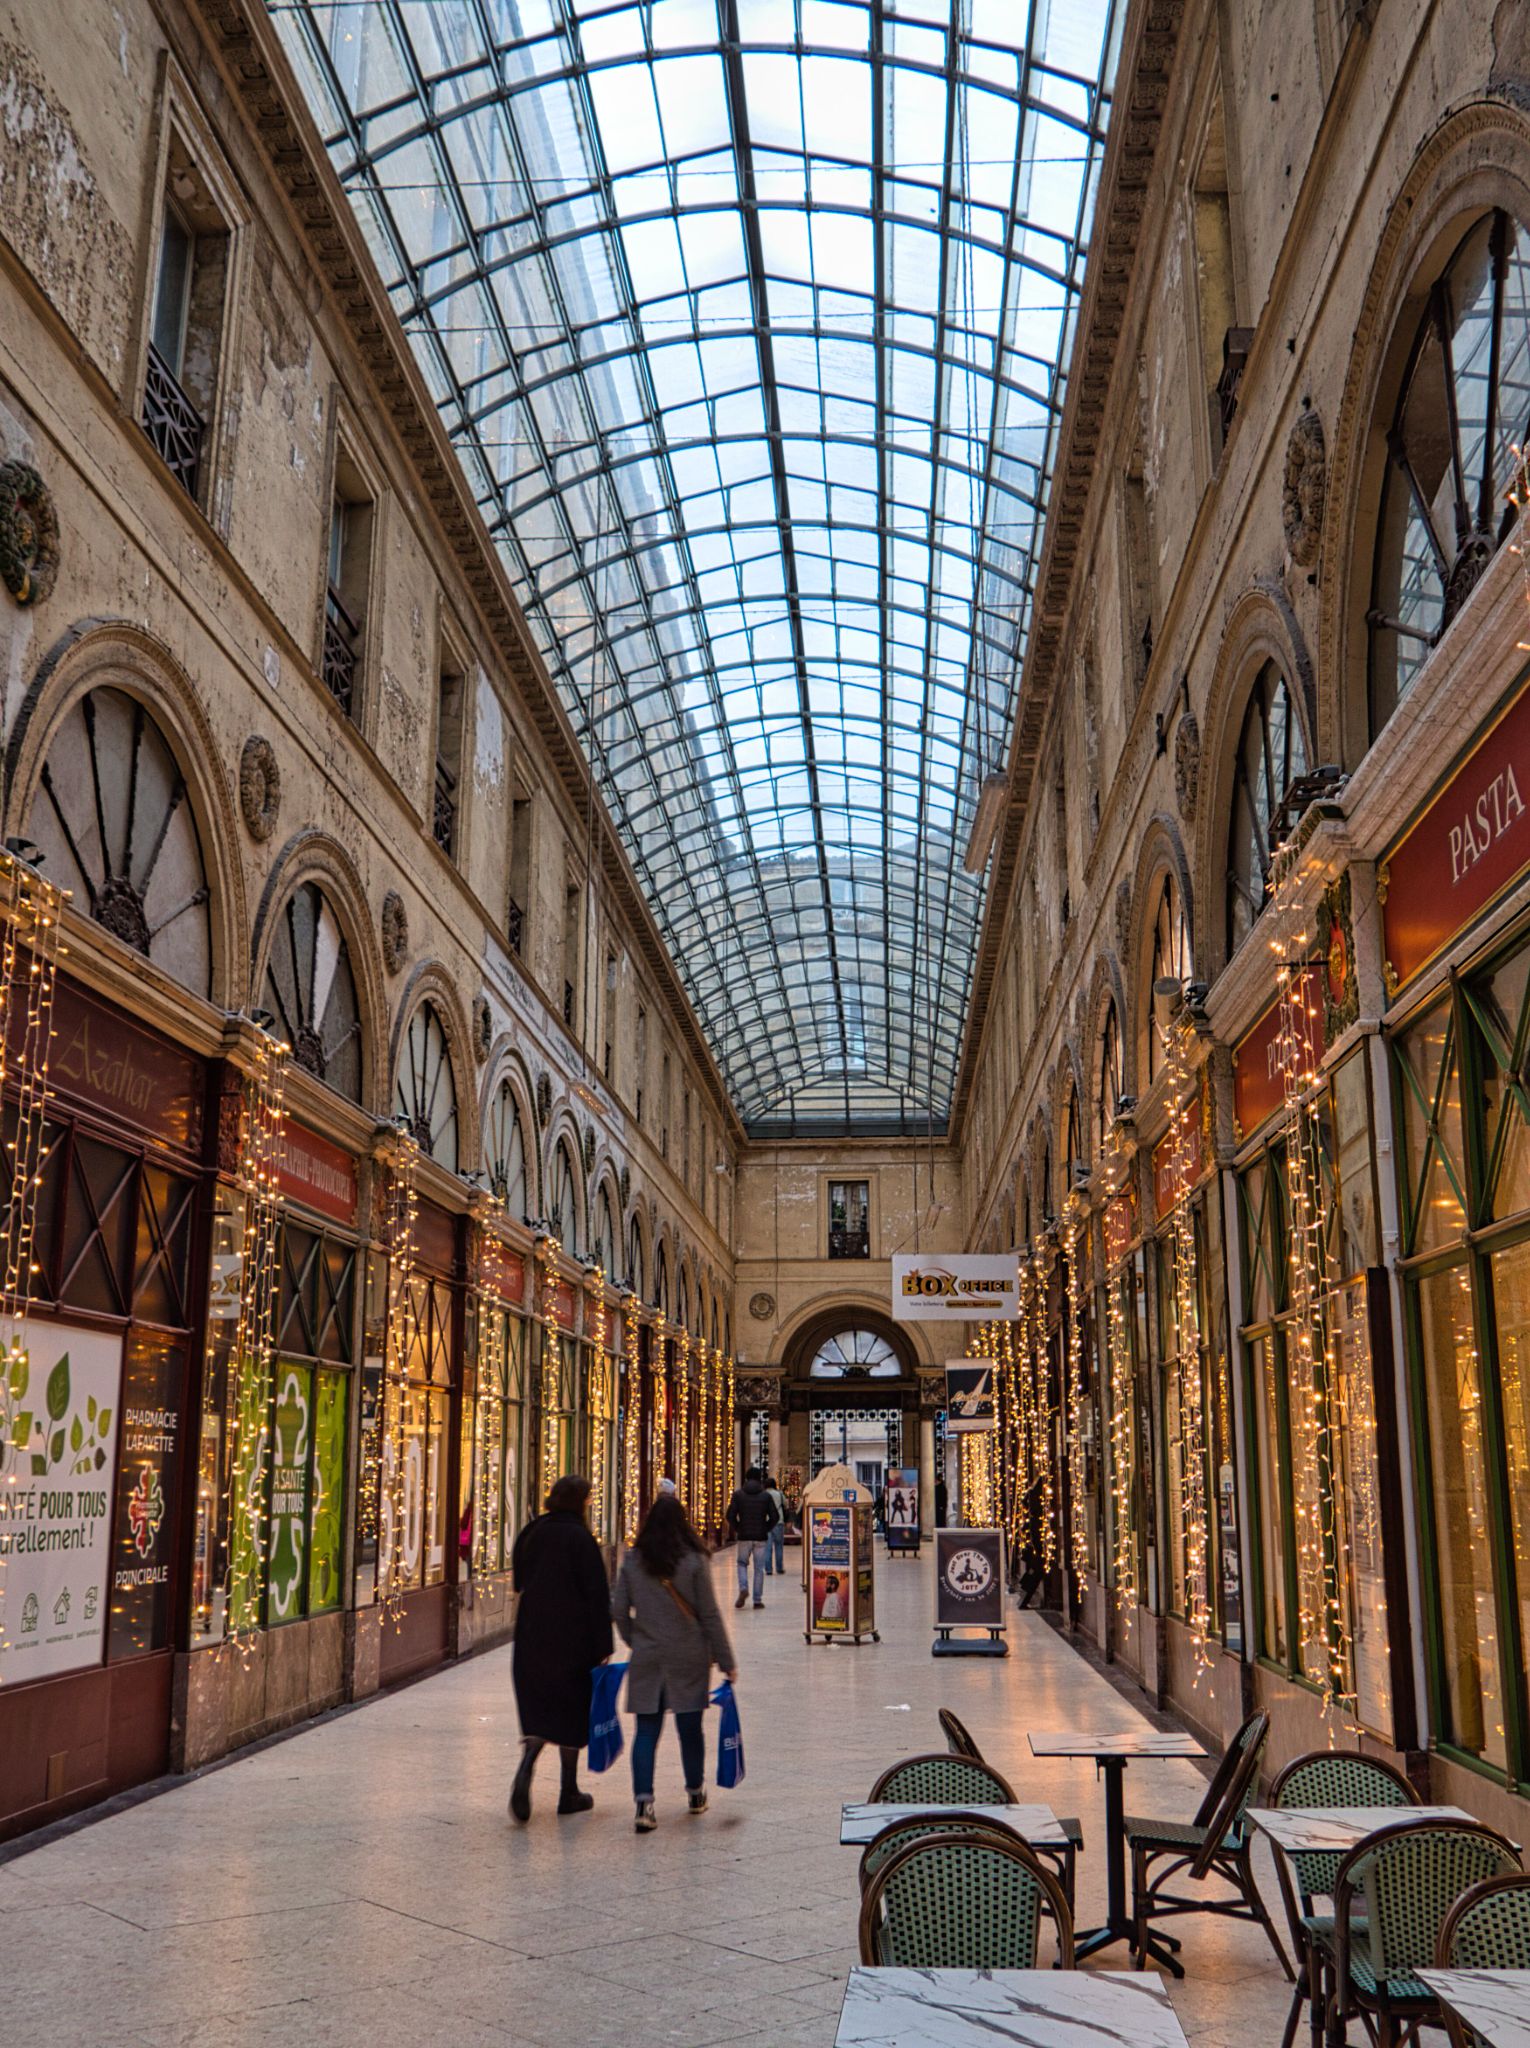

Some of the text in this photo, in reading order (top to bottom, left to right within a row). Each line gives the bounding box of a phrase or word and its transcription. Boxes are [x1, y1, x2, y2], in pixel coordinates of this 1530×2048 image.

[1448, 763, 1525, 884] PASTA
[56, 1015, 158, 1112] Azahar
[902, 1274, 1013, 1297] BOX OFFICE
[126, 1409, 177, 1429] PHARMACIE
[126, 1433, 174, 1452] LAFAYETTE
[39, 1491, 73, 1519] POUR
[78, 1491, 107, 1518] TOUS
[89, 1521, 93, 1547] !
[949, 1560, 957, 1575] Just
[956, 1552, 971, 1561] Over
[973, 1552, 984, 1562] The
[115, 1565, 168, 1588] PRINCIPALE
